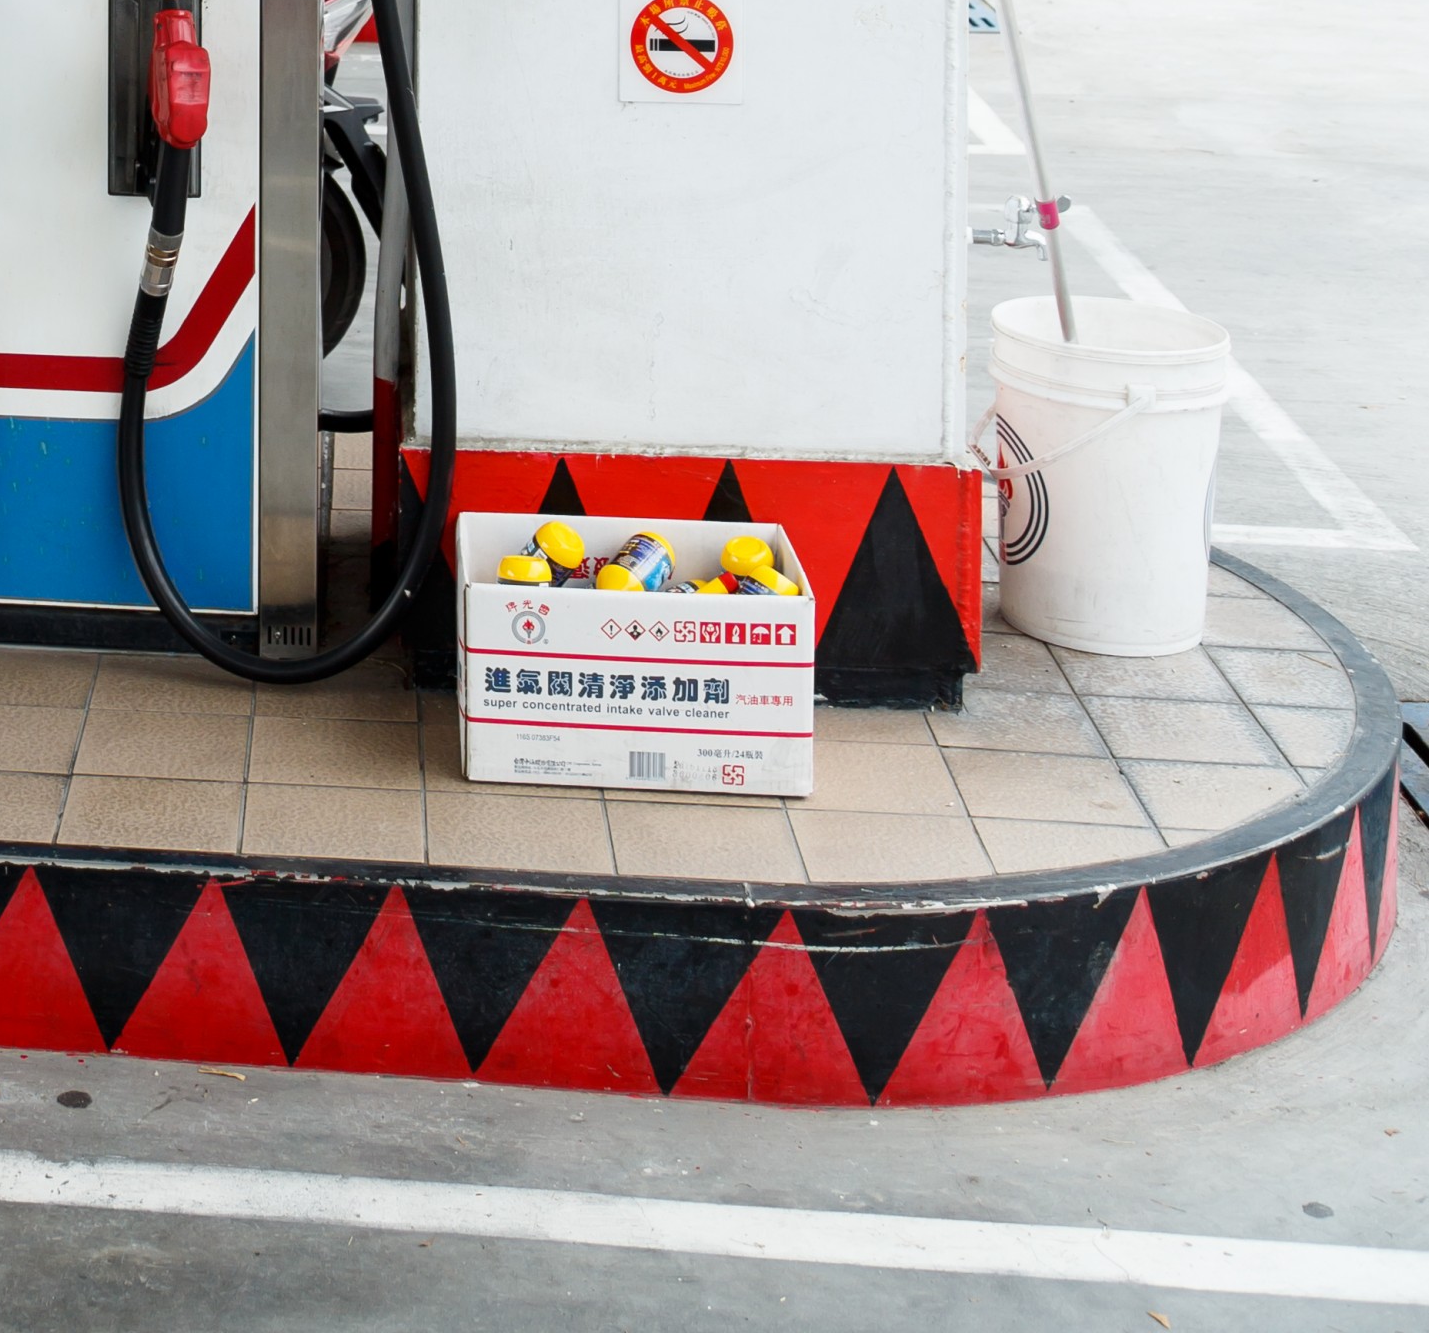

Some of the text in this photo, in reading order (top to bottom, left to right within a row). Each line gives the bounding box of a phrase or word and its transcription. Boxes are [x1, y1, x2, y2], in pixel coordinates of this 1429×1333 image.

[484, 666, 730, 704] 進氣閥清淨添加劑
[483, 697, 730, 719] super concentrated intake valve cleaner
